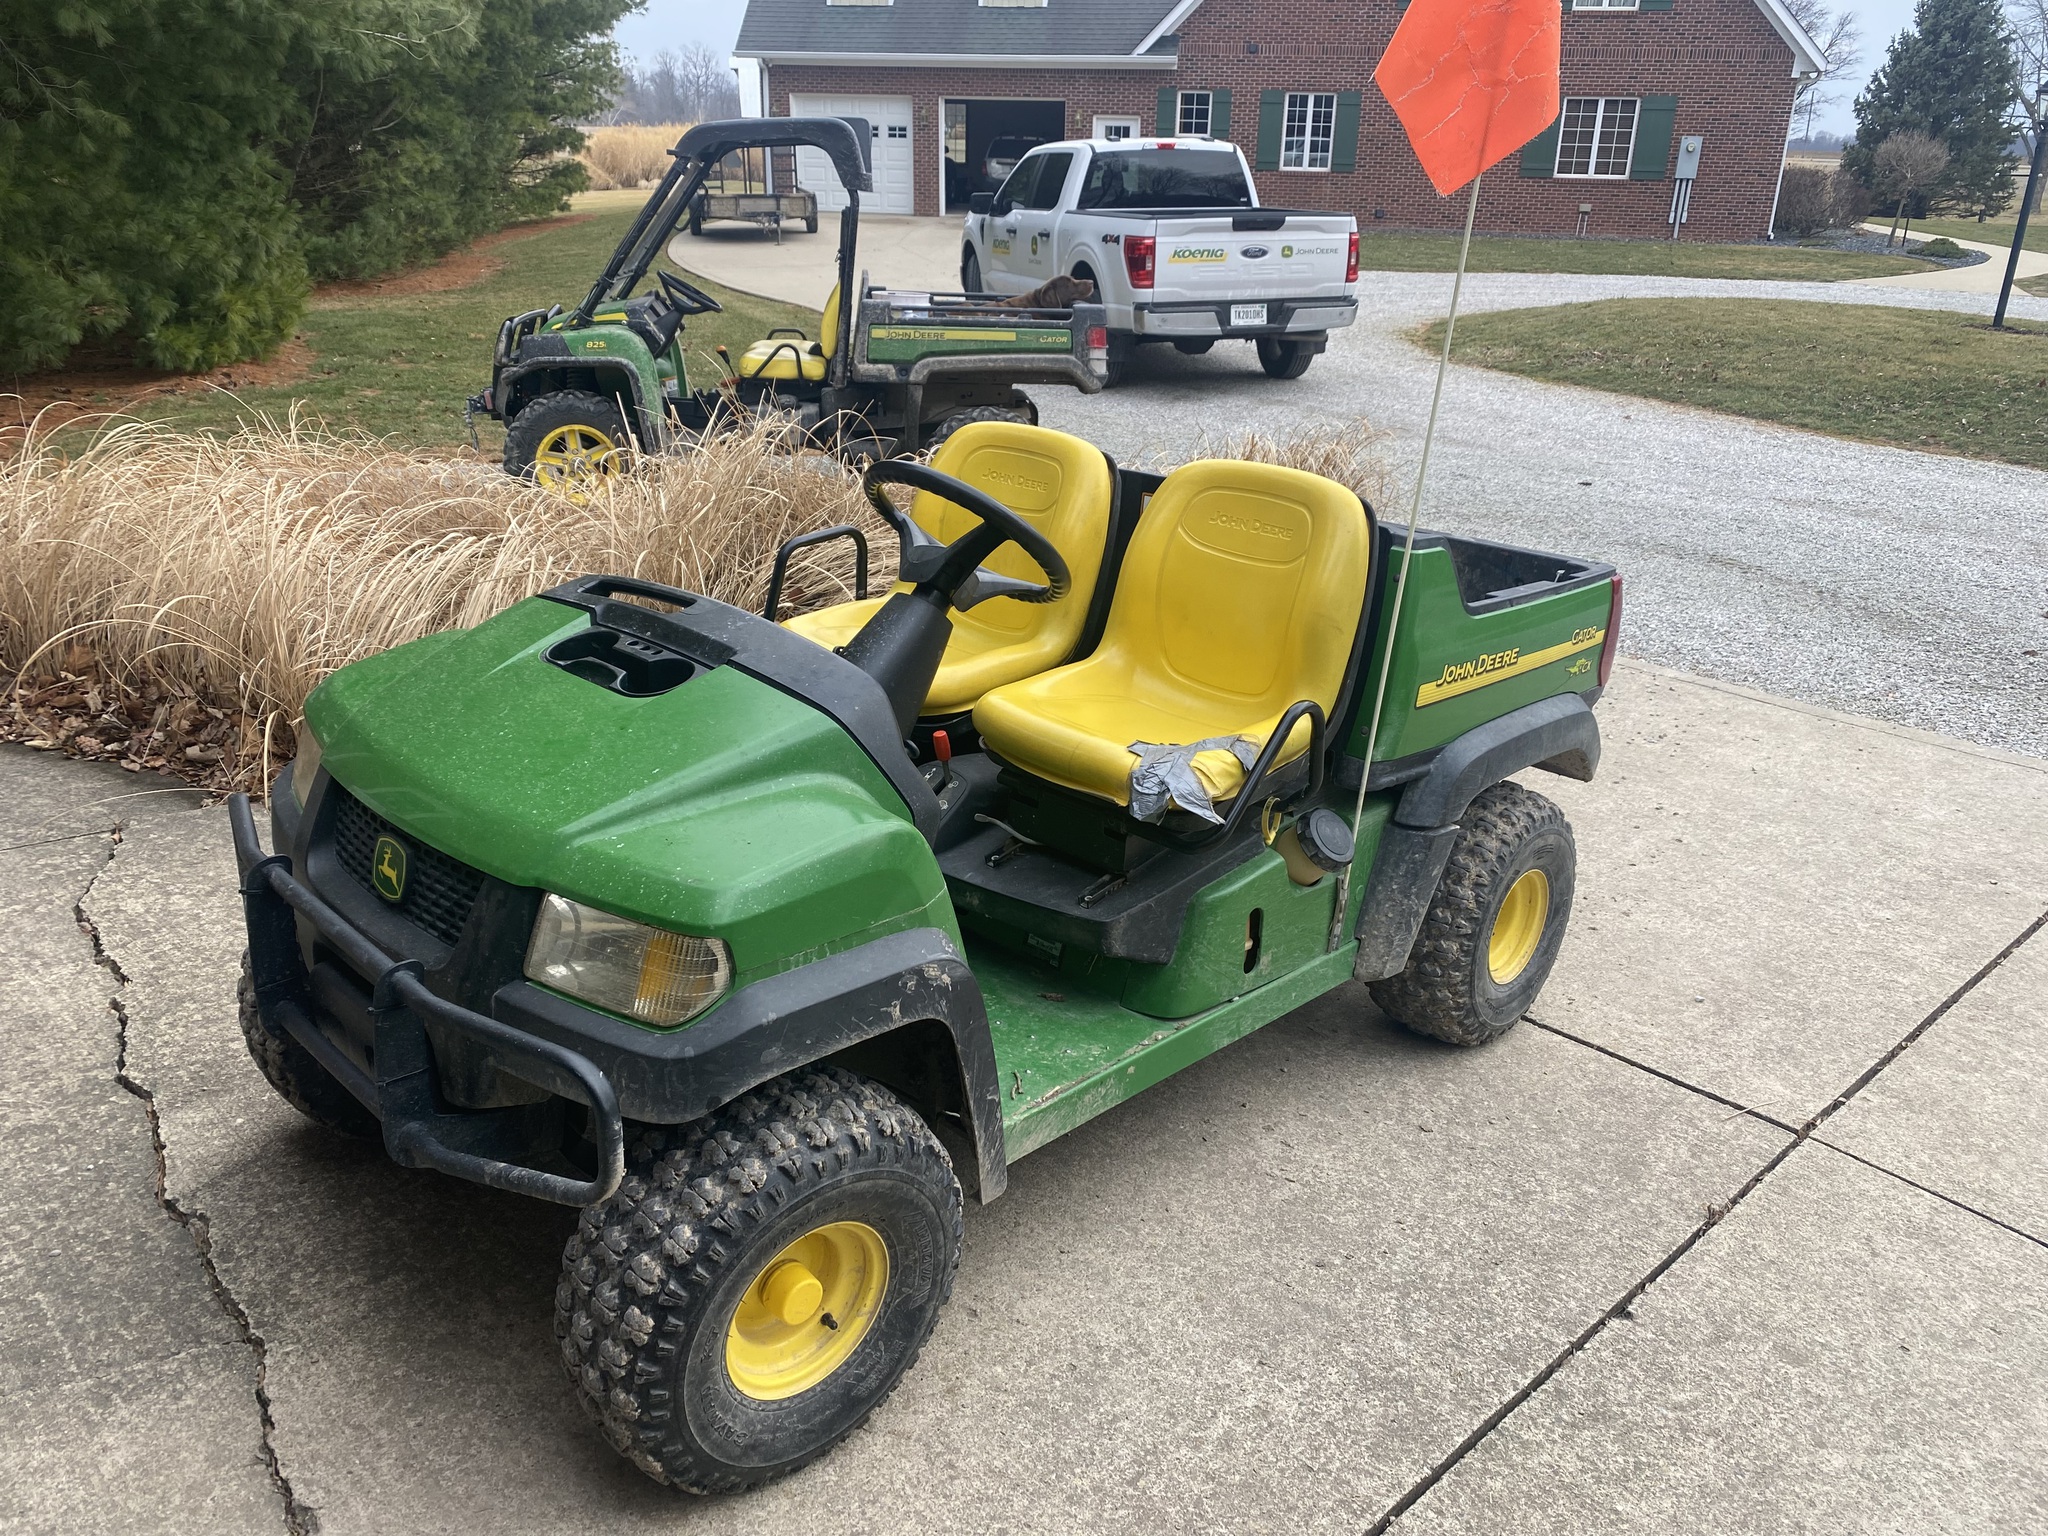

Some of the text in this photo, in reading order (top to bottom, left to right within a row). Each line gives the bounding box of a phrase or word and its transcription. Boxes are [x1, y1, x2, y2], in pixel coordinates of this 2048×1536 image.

[1295, 247, 1339, 255] JOHN DEERE
[886, 329, 946, 340] JOHN DEERE
[1039, 335, 1068, 343] GATOR
[981, 468, 1049, 493] JOHN DEERE
[1209, 511, 1294, 540] JOHN DEERE
[1571, 626, 1597, 645] GATOR
[1436, 646, 1520, 687] JOHN DEERE
